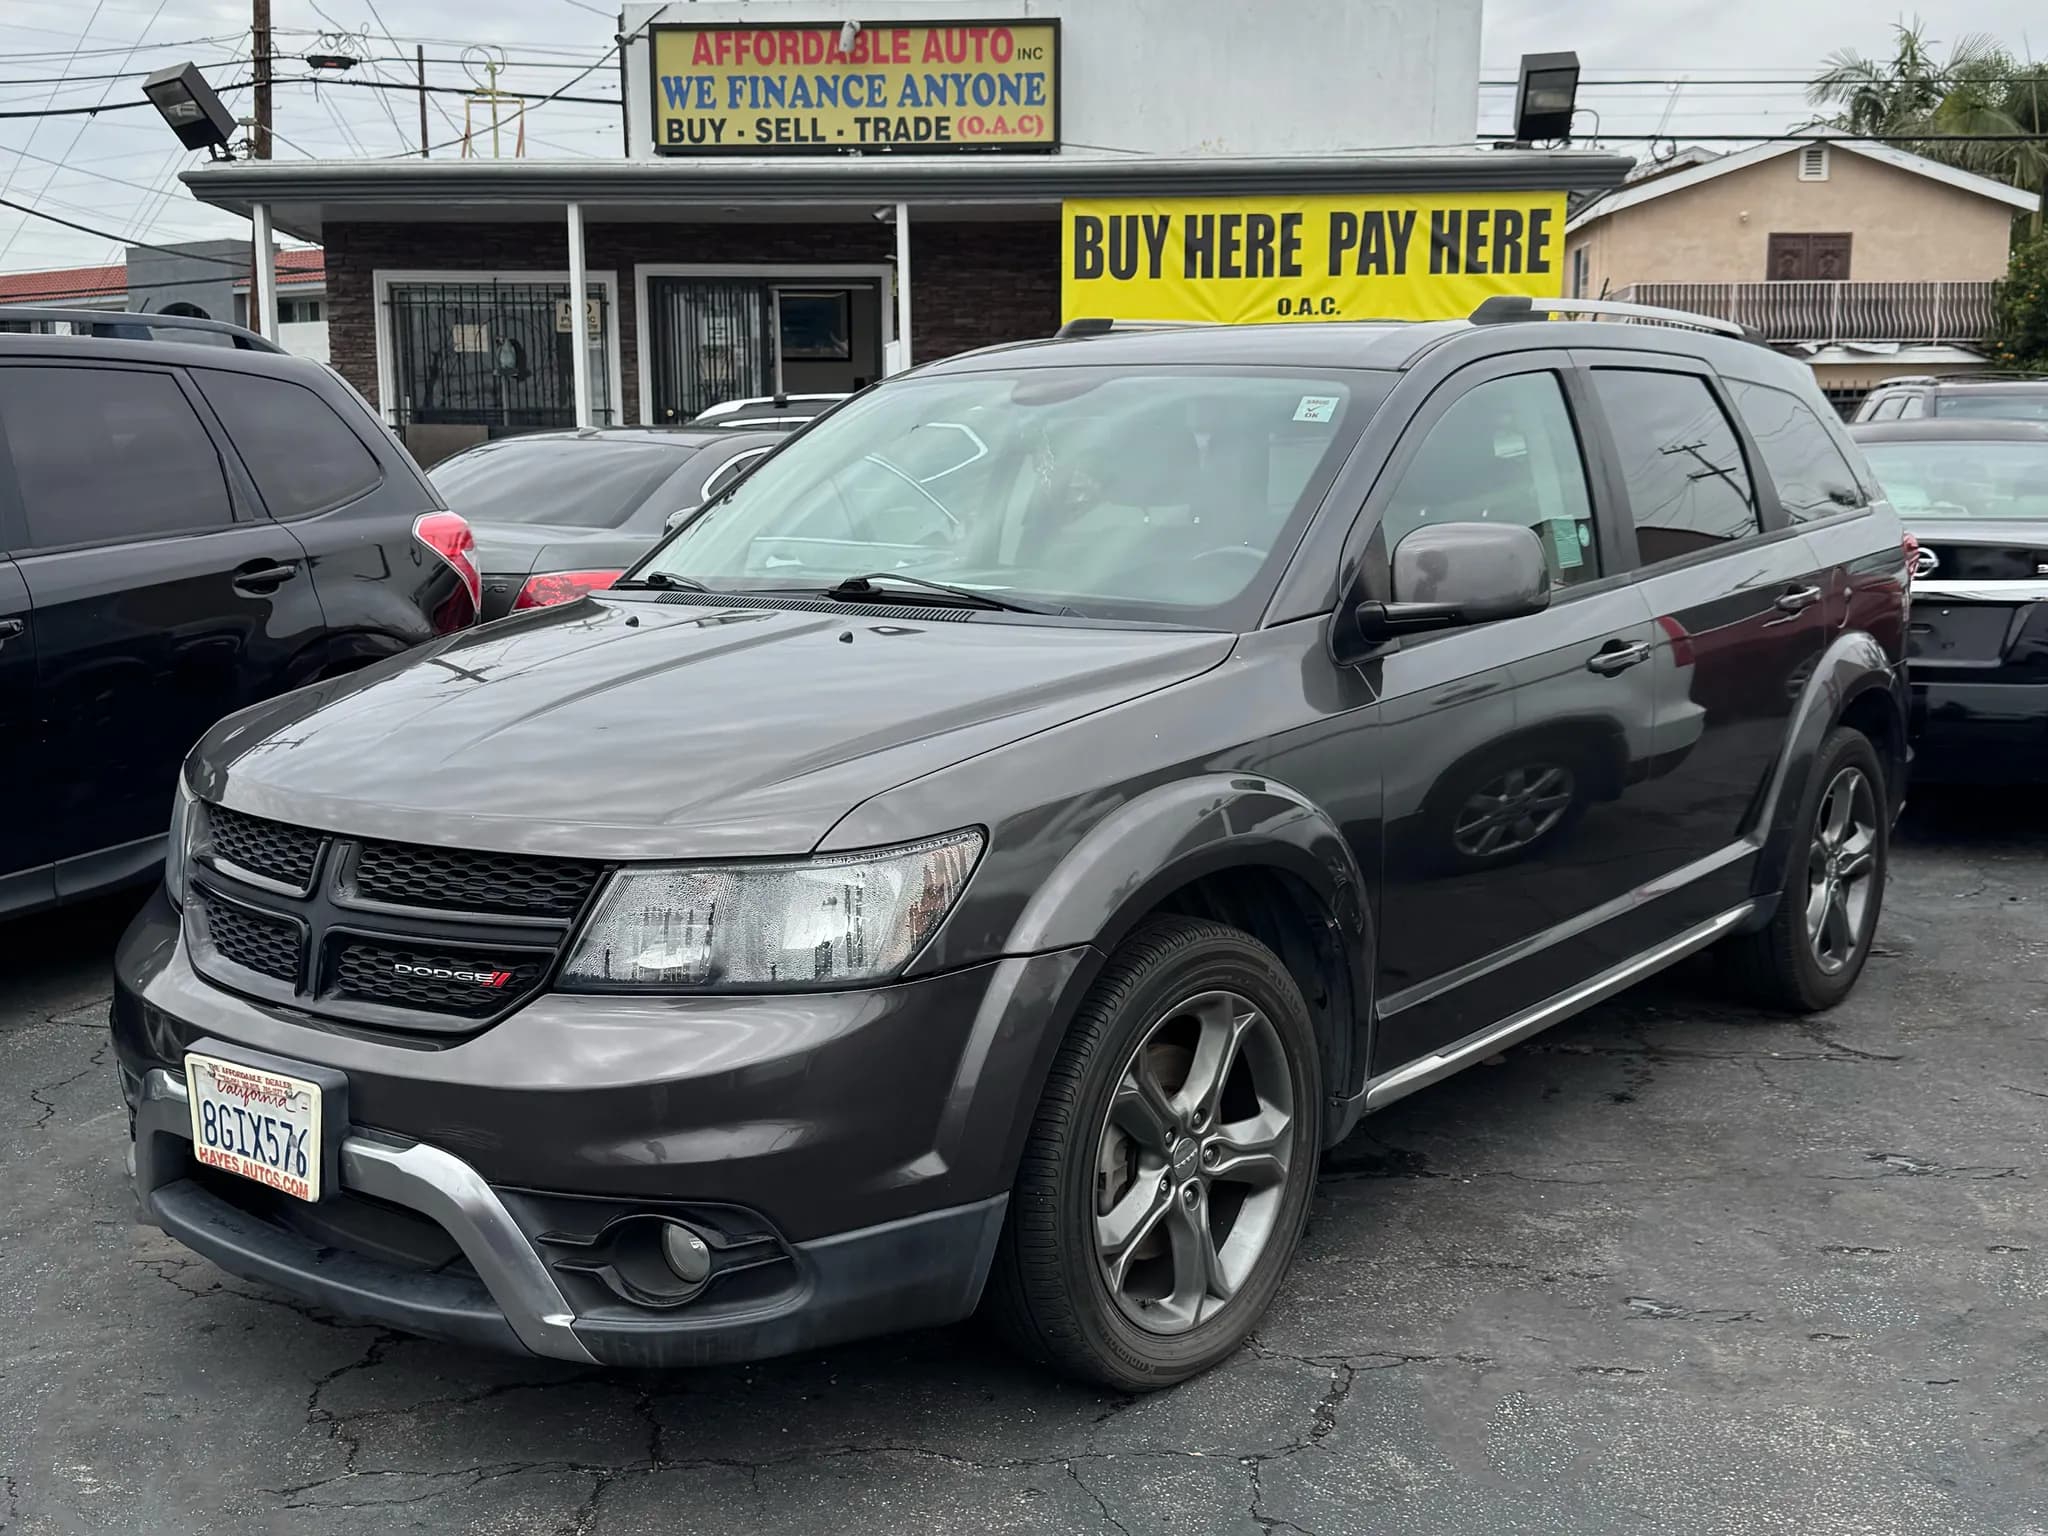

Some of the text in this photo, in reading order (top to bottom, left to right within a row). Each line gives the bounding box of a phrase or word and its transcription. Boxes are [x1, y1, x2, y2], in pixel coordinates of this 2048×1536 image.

[921, 28, 1014, 64] AUTO
[1016, 46, 1043, 61] INC
[660, 72, 1046, 110] WE FINANCE ANYONE
[666, 114, 1044, 143] BUY SELL TRADE (O.A.C)
[1074, 208, 1552, 281] BUY HERE PAY HERE
[1277, 297, 1342, 316] O.A.C.
[394, 963, 495, 983] DODGE
[203, 1099, 308, 1178] 8GIX576
[199, 1147, 309, 1200] HAYES AUTOS.COM
